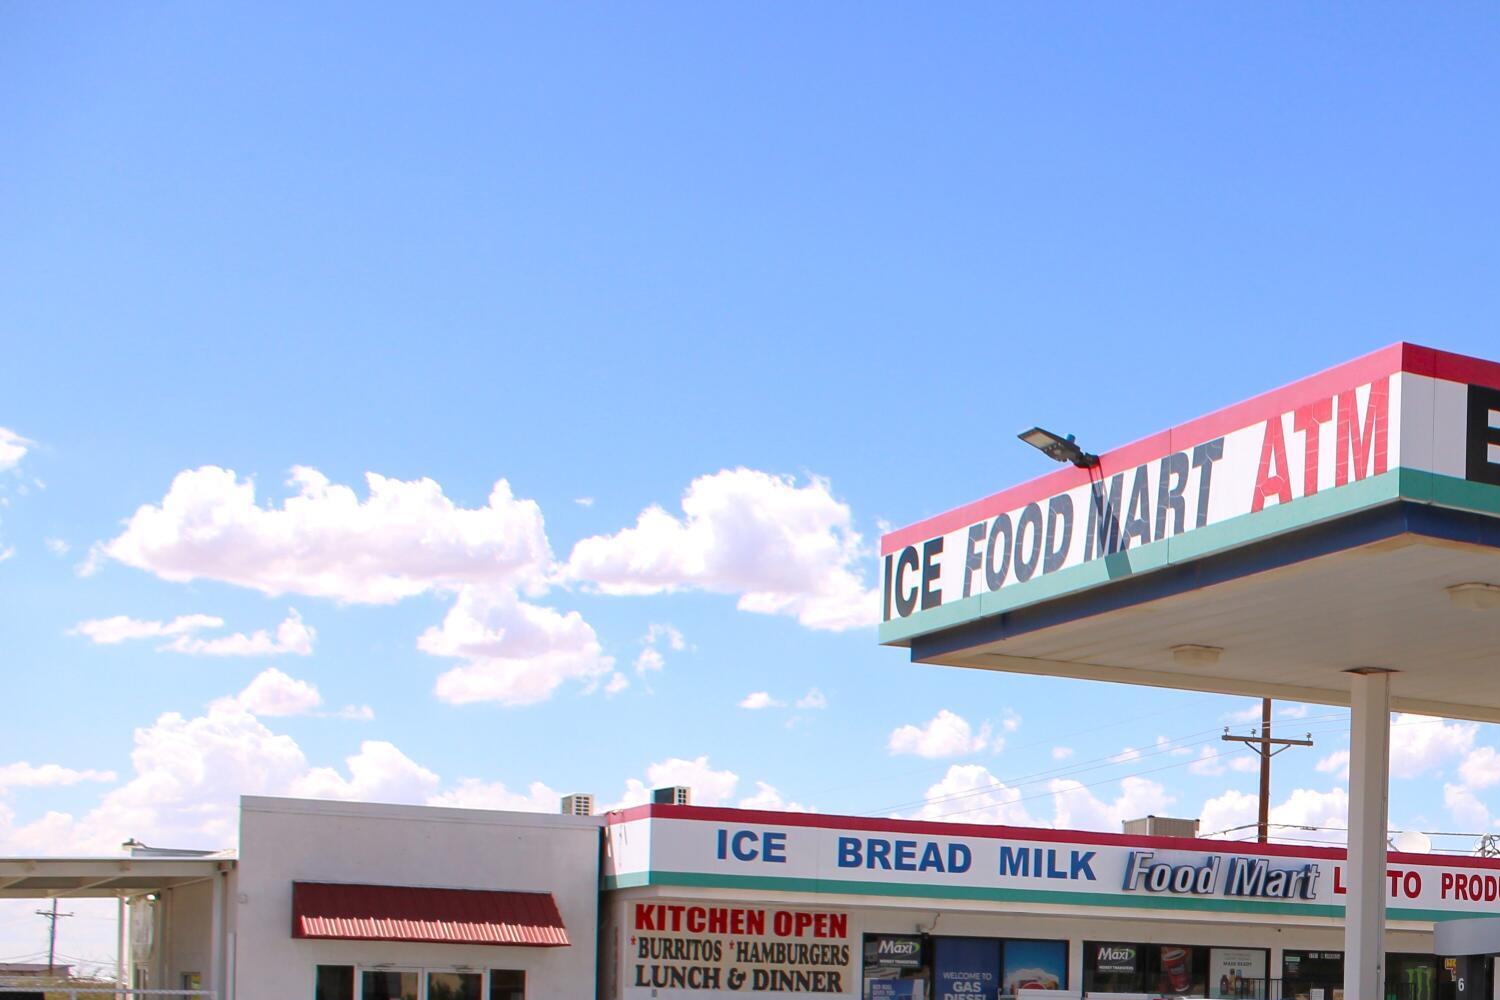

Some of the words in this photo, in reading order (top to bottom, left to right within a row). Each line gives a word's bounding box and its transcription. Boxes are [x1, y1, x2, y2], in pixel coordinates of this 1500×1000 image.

[883, 537, 944, 622] ICE
[962, 493, 1074, 599] FOOD
[1084, 437, 1224, 564] MART
[1251, 375, 1390, 513] ATM
[717, 829, 787, 863] ICE
[838, 836, 972, 874] BREAD
[1000, 846, 1097, 881] MILK
[1122, 851, 1221, 894] Food
[1224, 857, 1320, 899] Mart
[1334, 866, 1422, 899] LTO
[635, 904, 765, 936] KITCHEN
[773, 911, 847, 938] OPEN
[878, 940, 913, 954] Maxi
[1097, 947, 1129, 960] Maxi
[635, 964, 721, 989] LUNCH
[727, 967, 746, 990] &
[752, 968, 843, 993] DINNER
[943, 972, 981, 980] WELCOME
[982, 972, 993, 981] TO
[952, 981, 982, 993] GAS
[1458, 977, 1465, 992] 6
